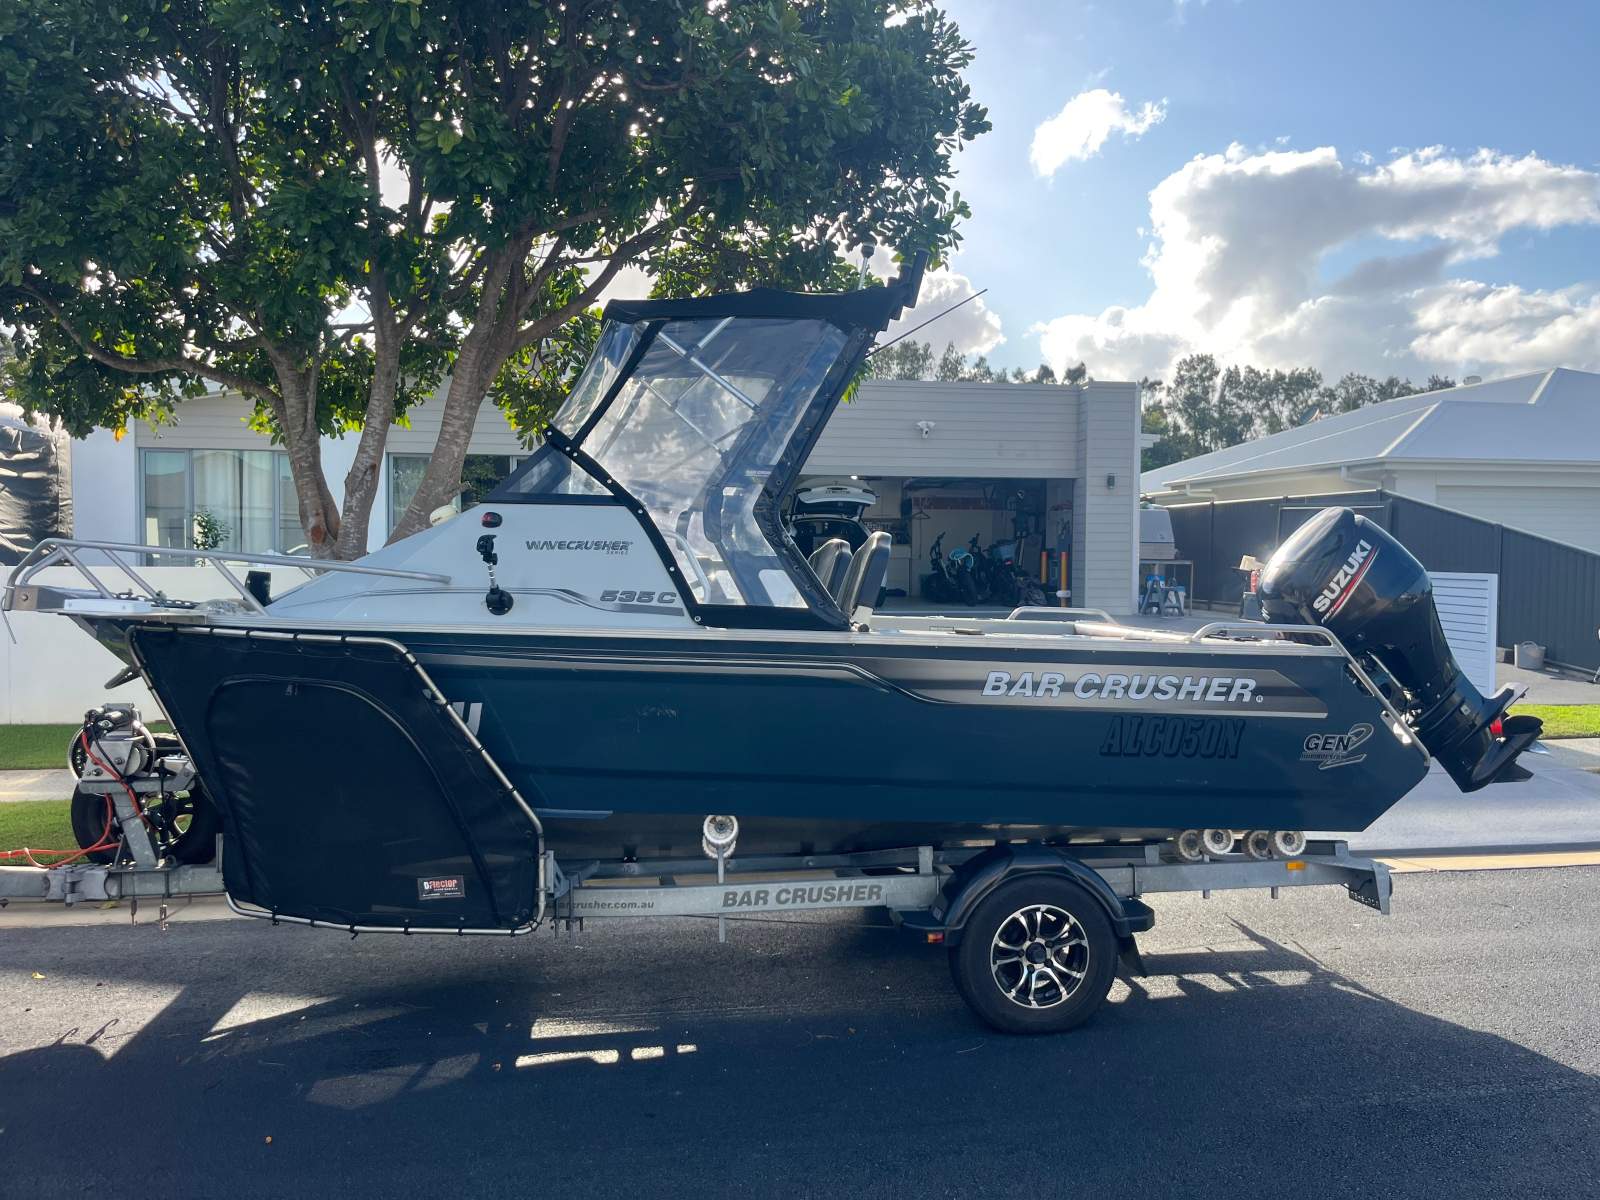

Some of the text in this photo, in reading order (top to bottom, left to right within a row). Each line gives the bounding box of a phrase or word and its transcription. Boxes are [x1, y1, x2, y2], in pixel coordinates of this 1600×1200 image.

[526, 540, 630, 551] WAVECRUSHER
[1313, 539, 1372, 613] SUZUKI
[981, 671, 1257, 703] BAR CRUSHER
[722, 884, 883, 908] BAR CRUSHER
